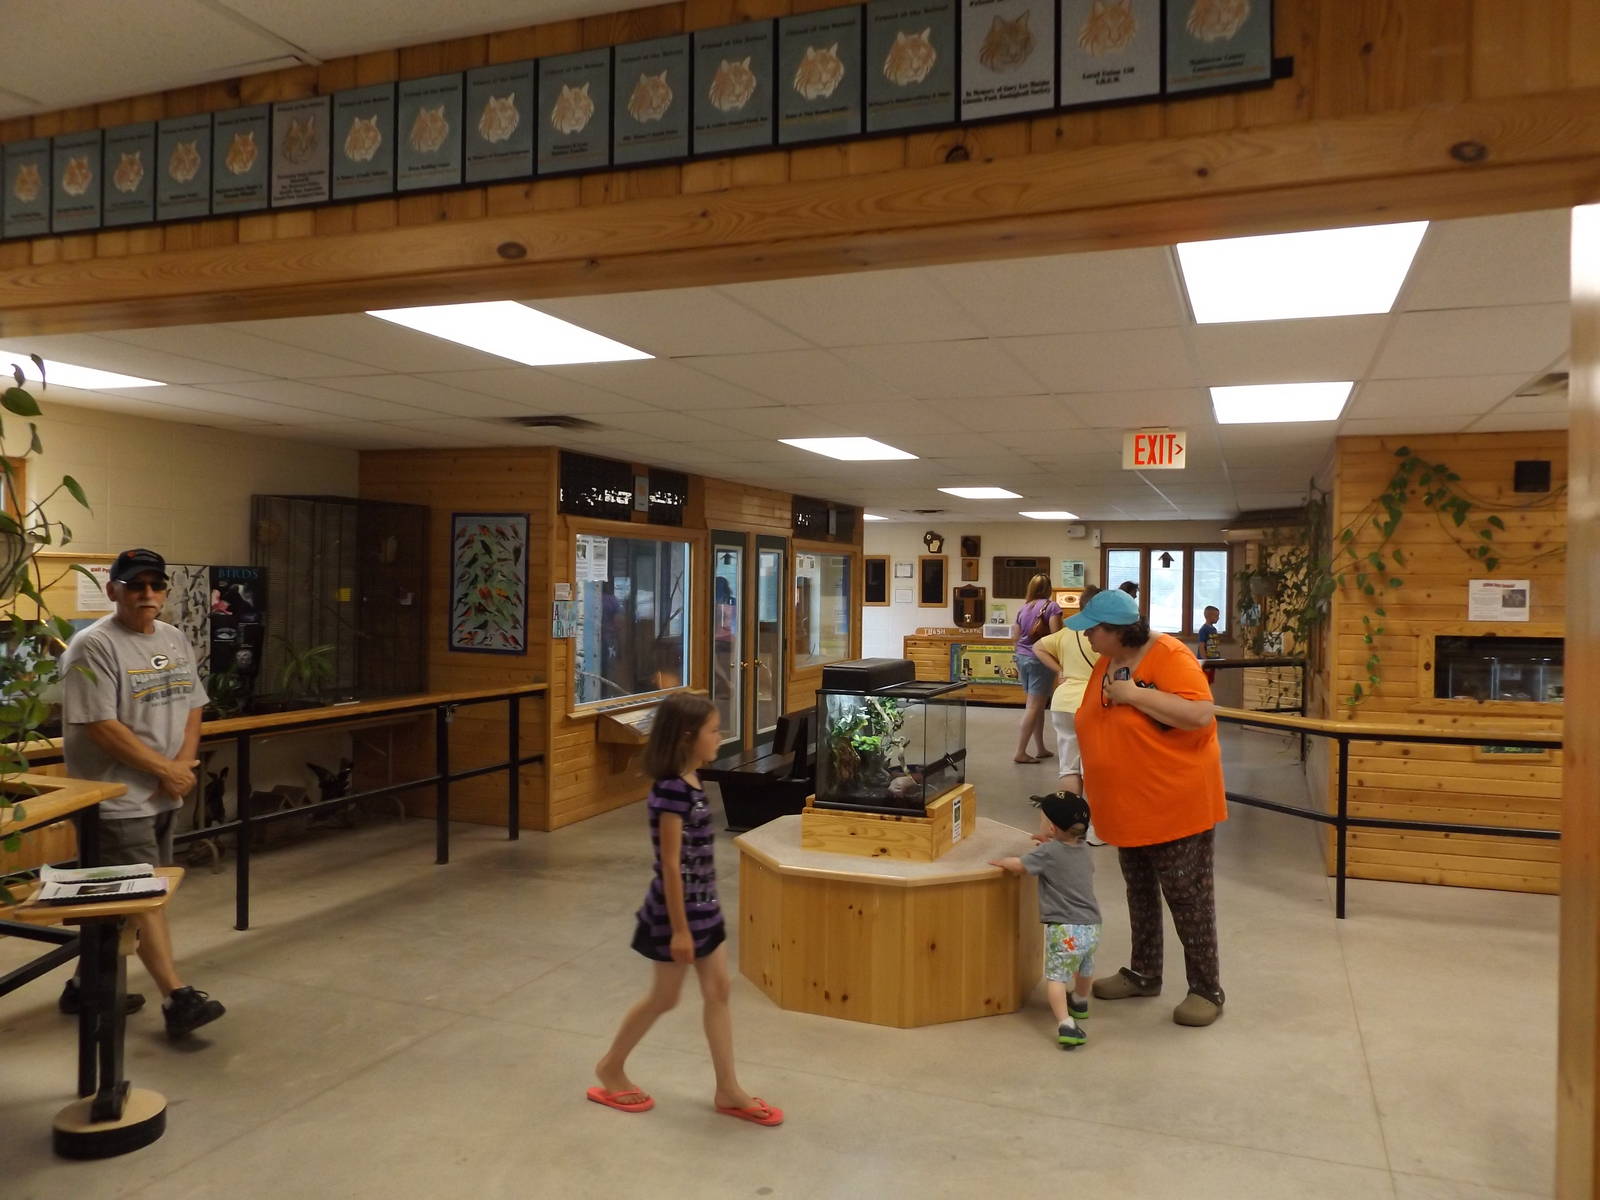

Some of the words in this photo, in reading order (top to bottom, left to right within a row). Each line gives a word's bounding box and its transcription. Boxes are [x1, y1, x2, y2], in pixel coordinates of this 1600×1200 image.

[1134, 434, 1176, 465] EXIT
[217, 567, 258, 579] BIRDS
[924, 628, 946, 636] TRASH
